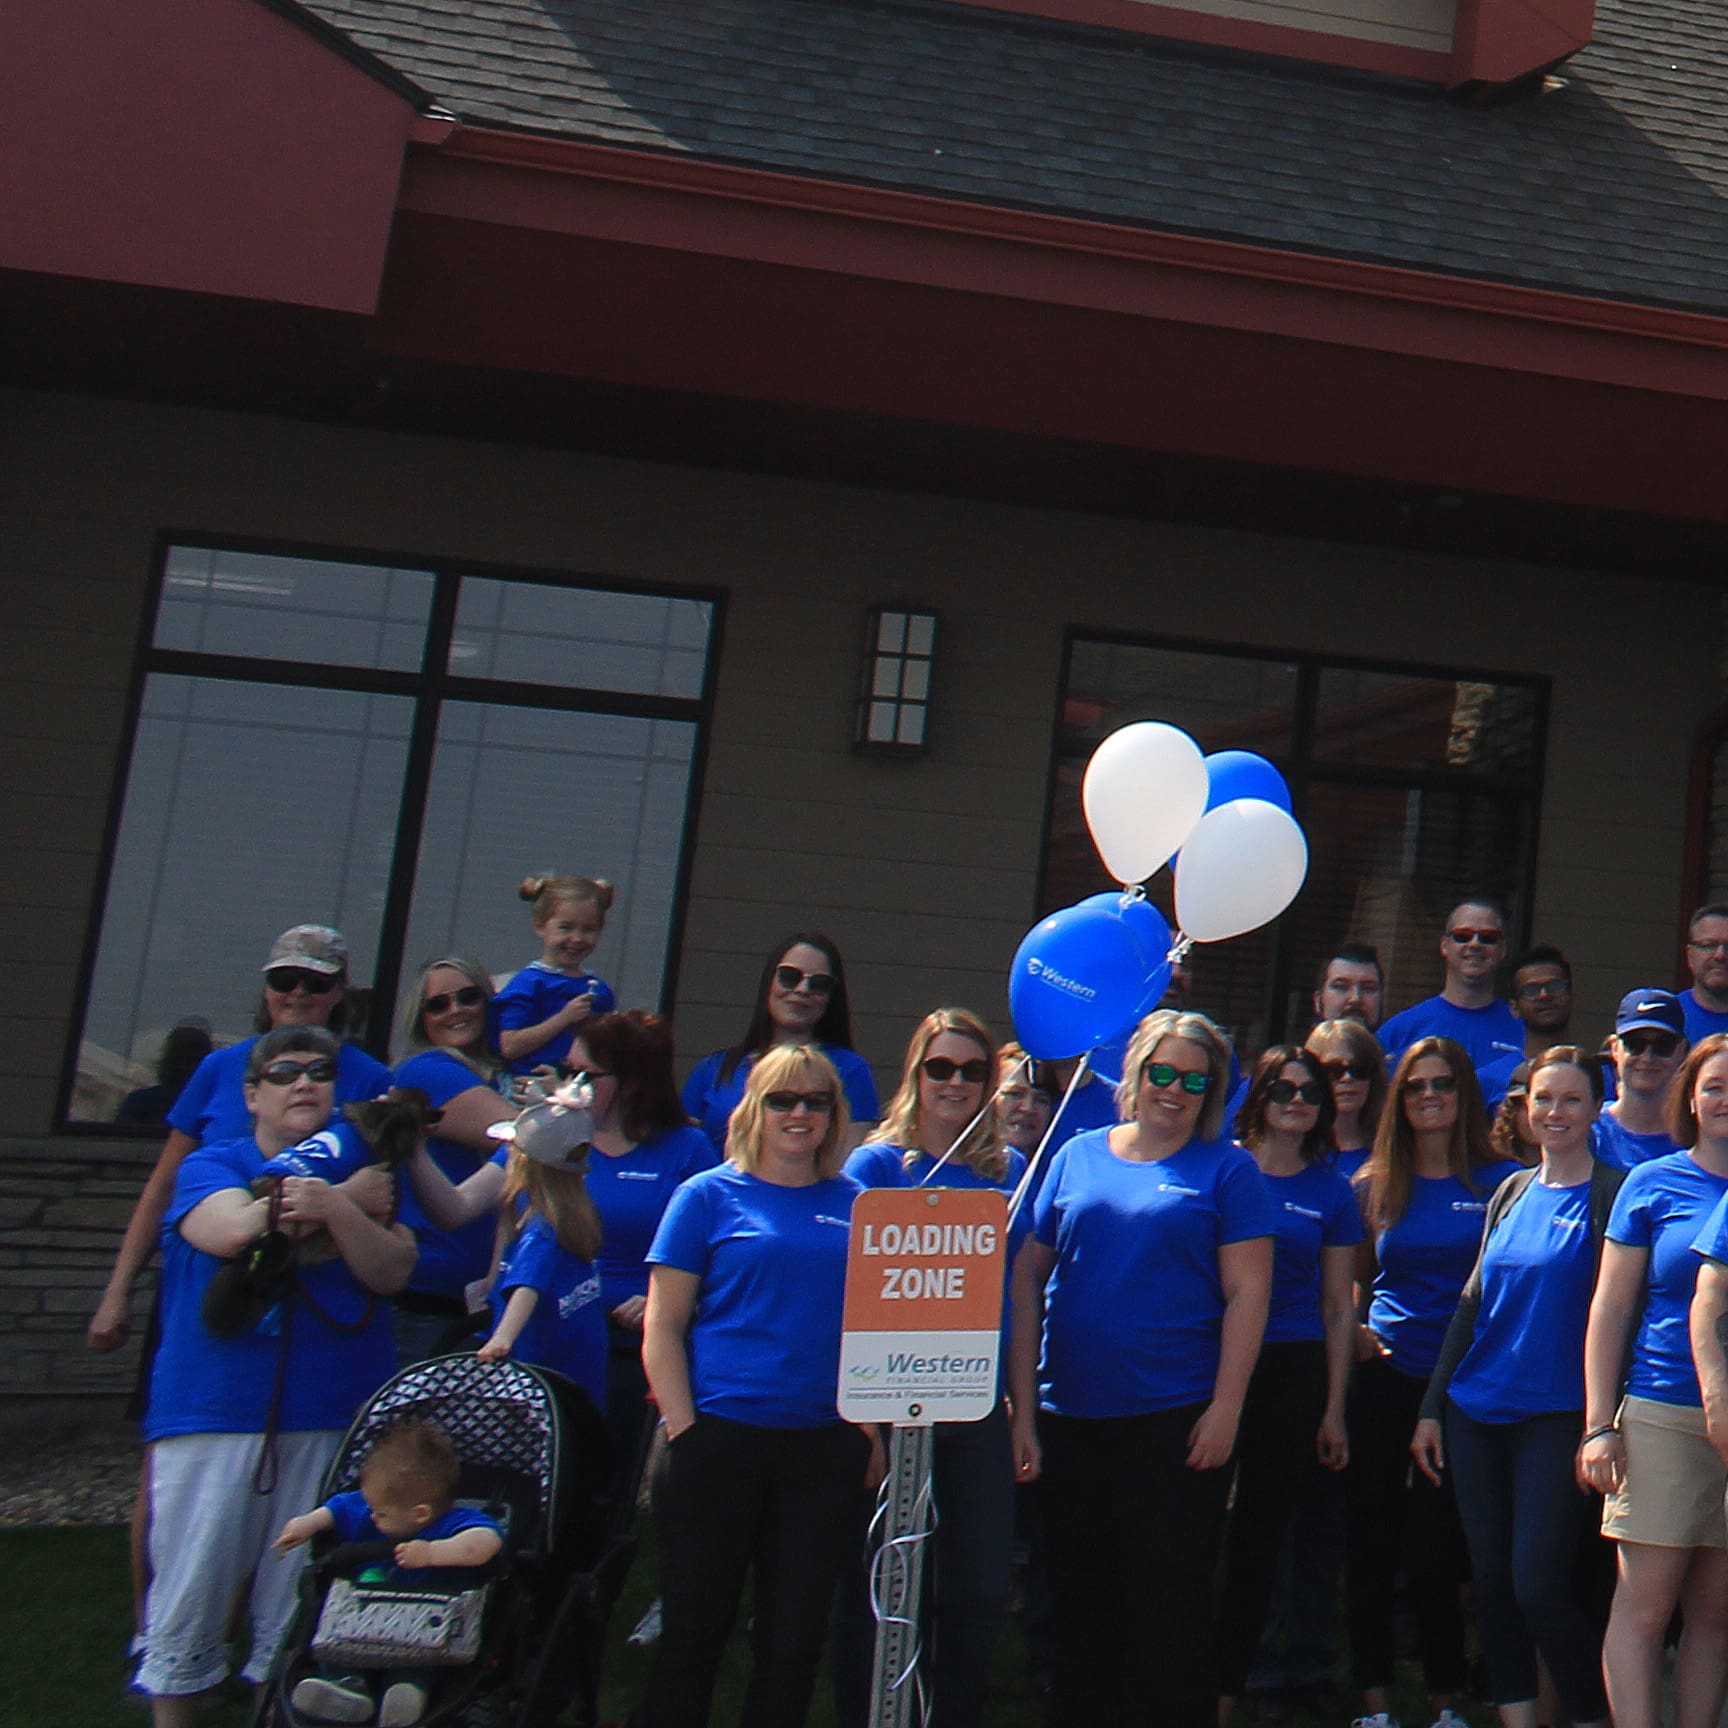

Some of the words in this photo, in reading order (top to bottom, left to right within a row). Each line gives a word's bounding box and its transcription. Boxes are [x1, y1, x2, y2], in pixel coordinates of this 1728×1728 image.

[1041, 965, 1097, 998] Western
[863, 1223, 997, 1256] LOADING
[880, 1268, 966, 1299] ZONE
[887, 1353, 991, 1374] Western
